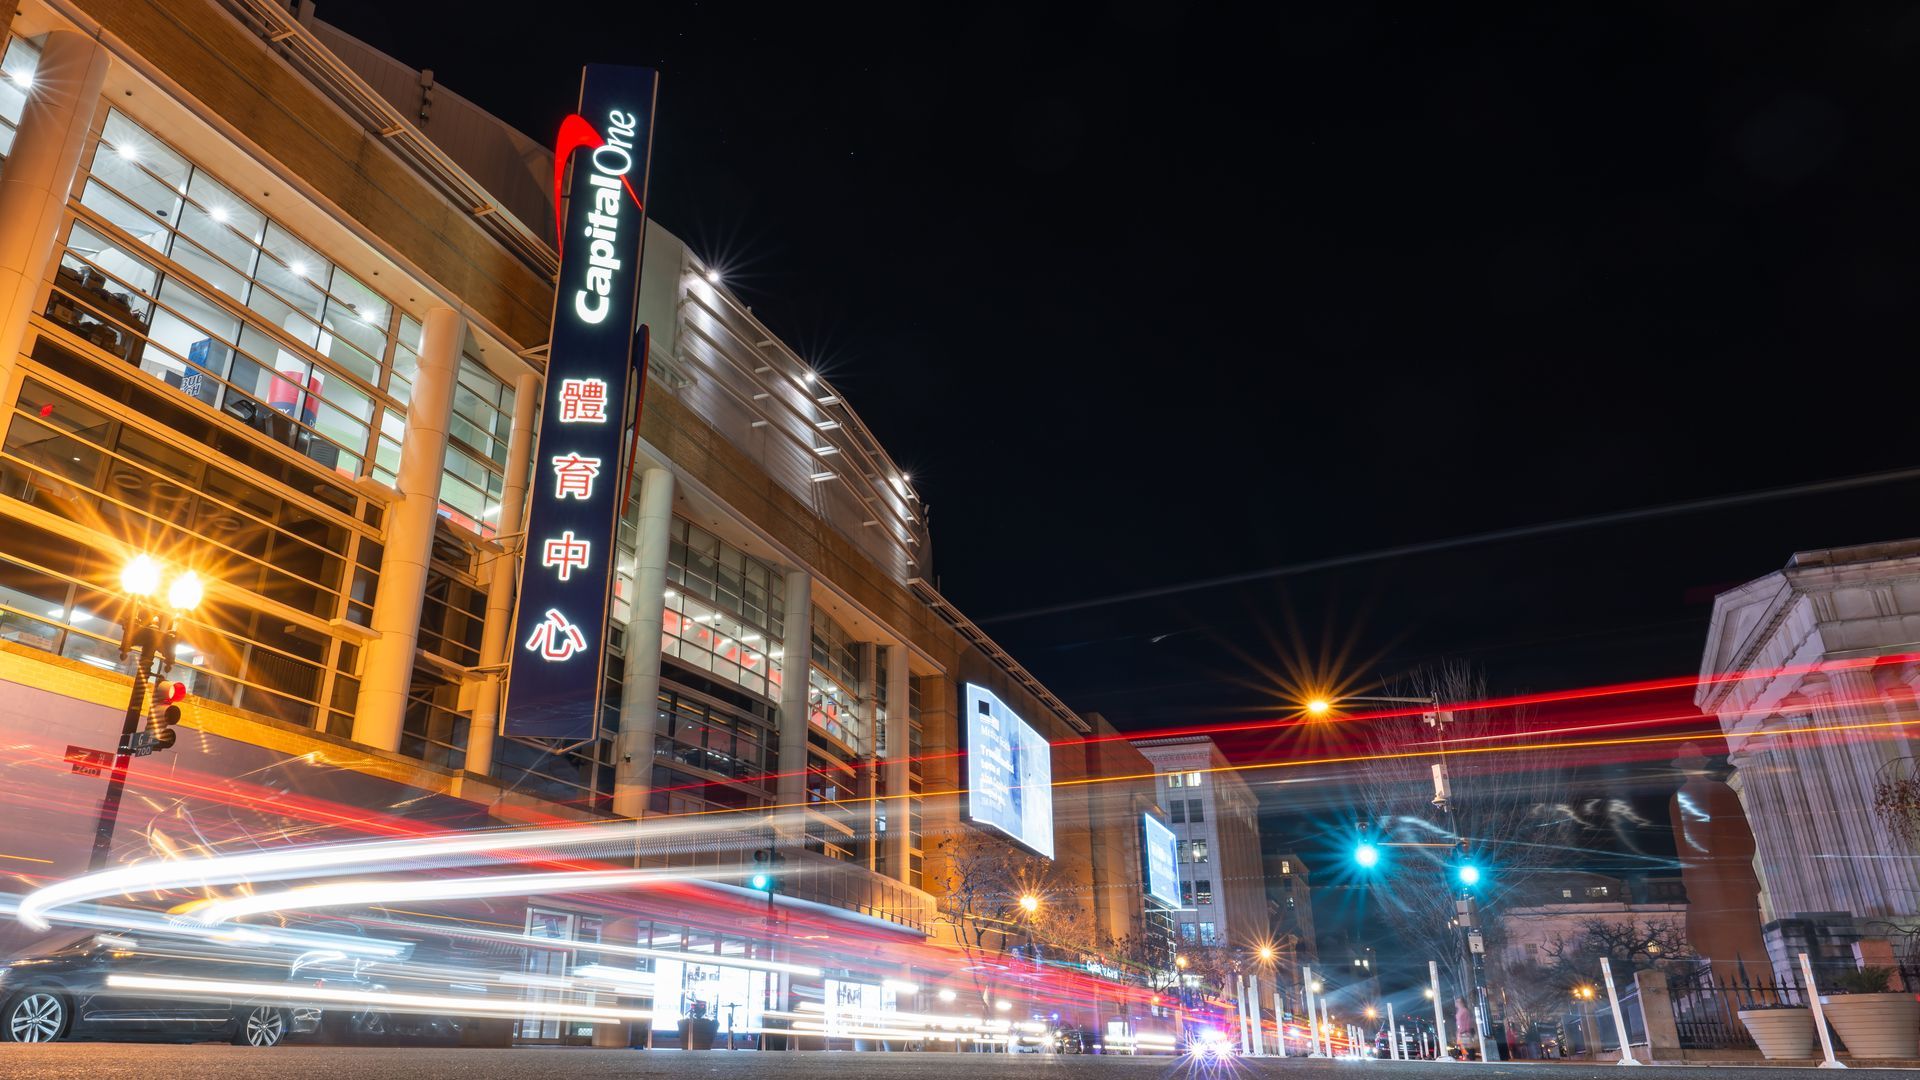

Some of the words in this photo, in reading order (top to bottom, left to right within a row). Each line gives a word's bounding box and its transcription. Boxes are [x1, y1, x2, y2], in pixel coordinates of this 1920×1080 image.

[526, 378, 608, 662] 體育中心
[137, 746, 151, 756] 700
